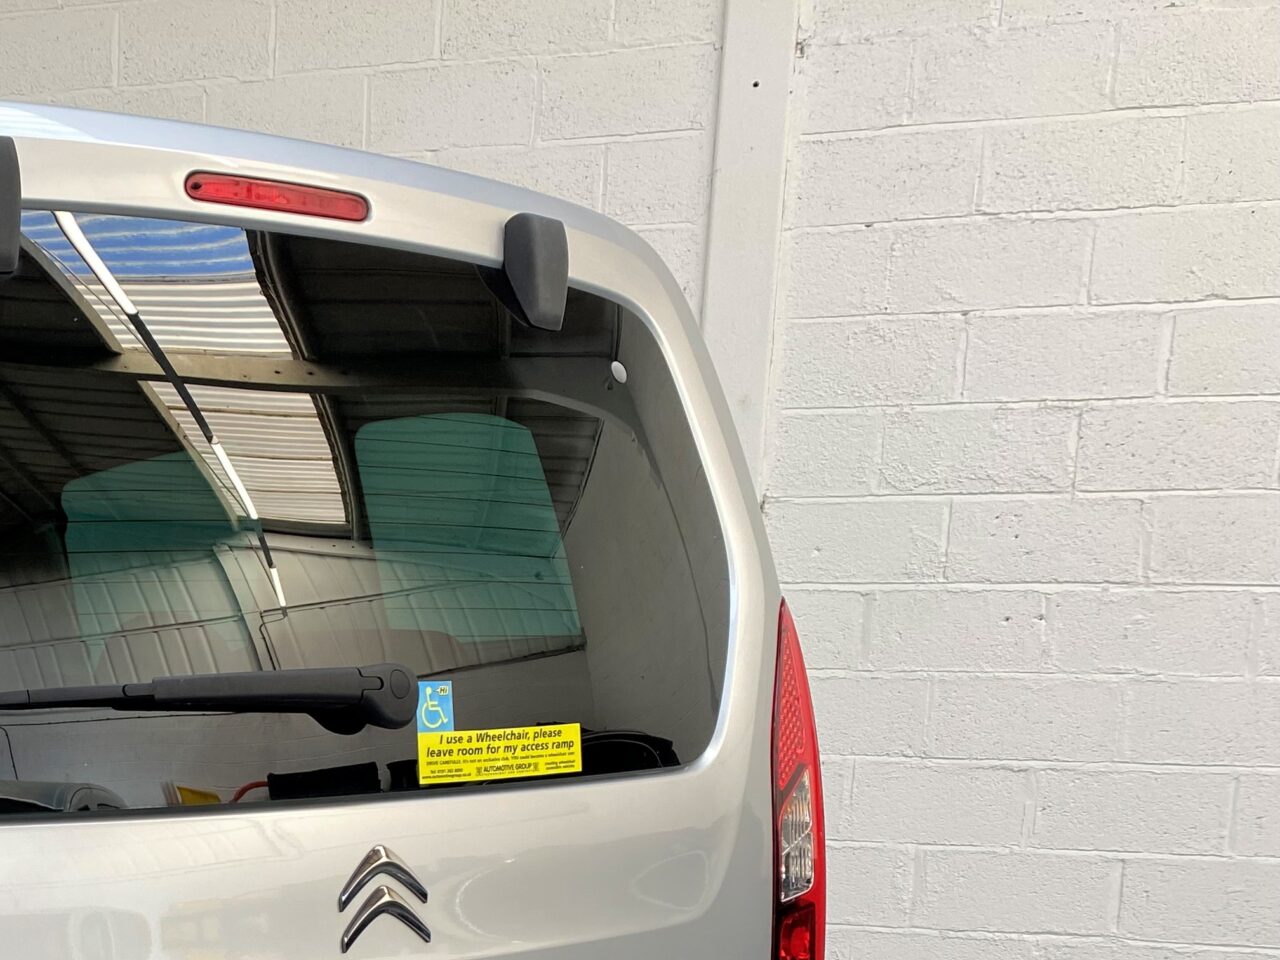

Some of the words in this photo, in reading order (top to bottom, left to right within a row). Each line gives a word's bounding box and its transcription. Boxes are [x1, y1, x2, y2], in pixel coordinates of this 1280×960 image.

[446, 735, 463, 744] use
[467, 735, 472, 743] a
[476, 730, 530, 743] Wheelchair,
[533, 729, 562, 741] please
[426, 747, 453, 757] leave
[457, 746, 483, 755] room
[486, 744, 500, 754] for
[503, 743, 518, 755] my
[521, 742, 549, 752] access
[552, 740, 574, 750] ramp
[483, 764, 514, 772] AUTOMOTIVE
[515, 762, 532, 770] GROUP
